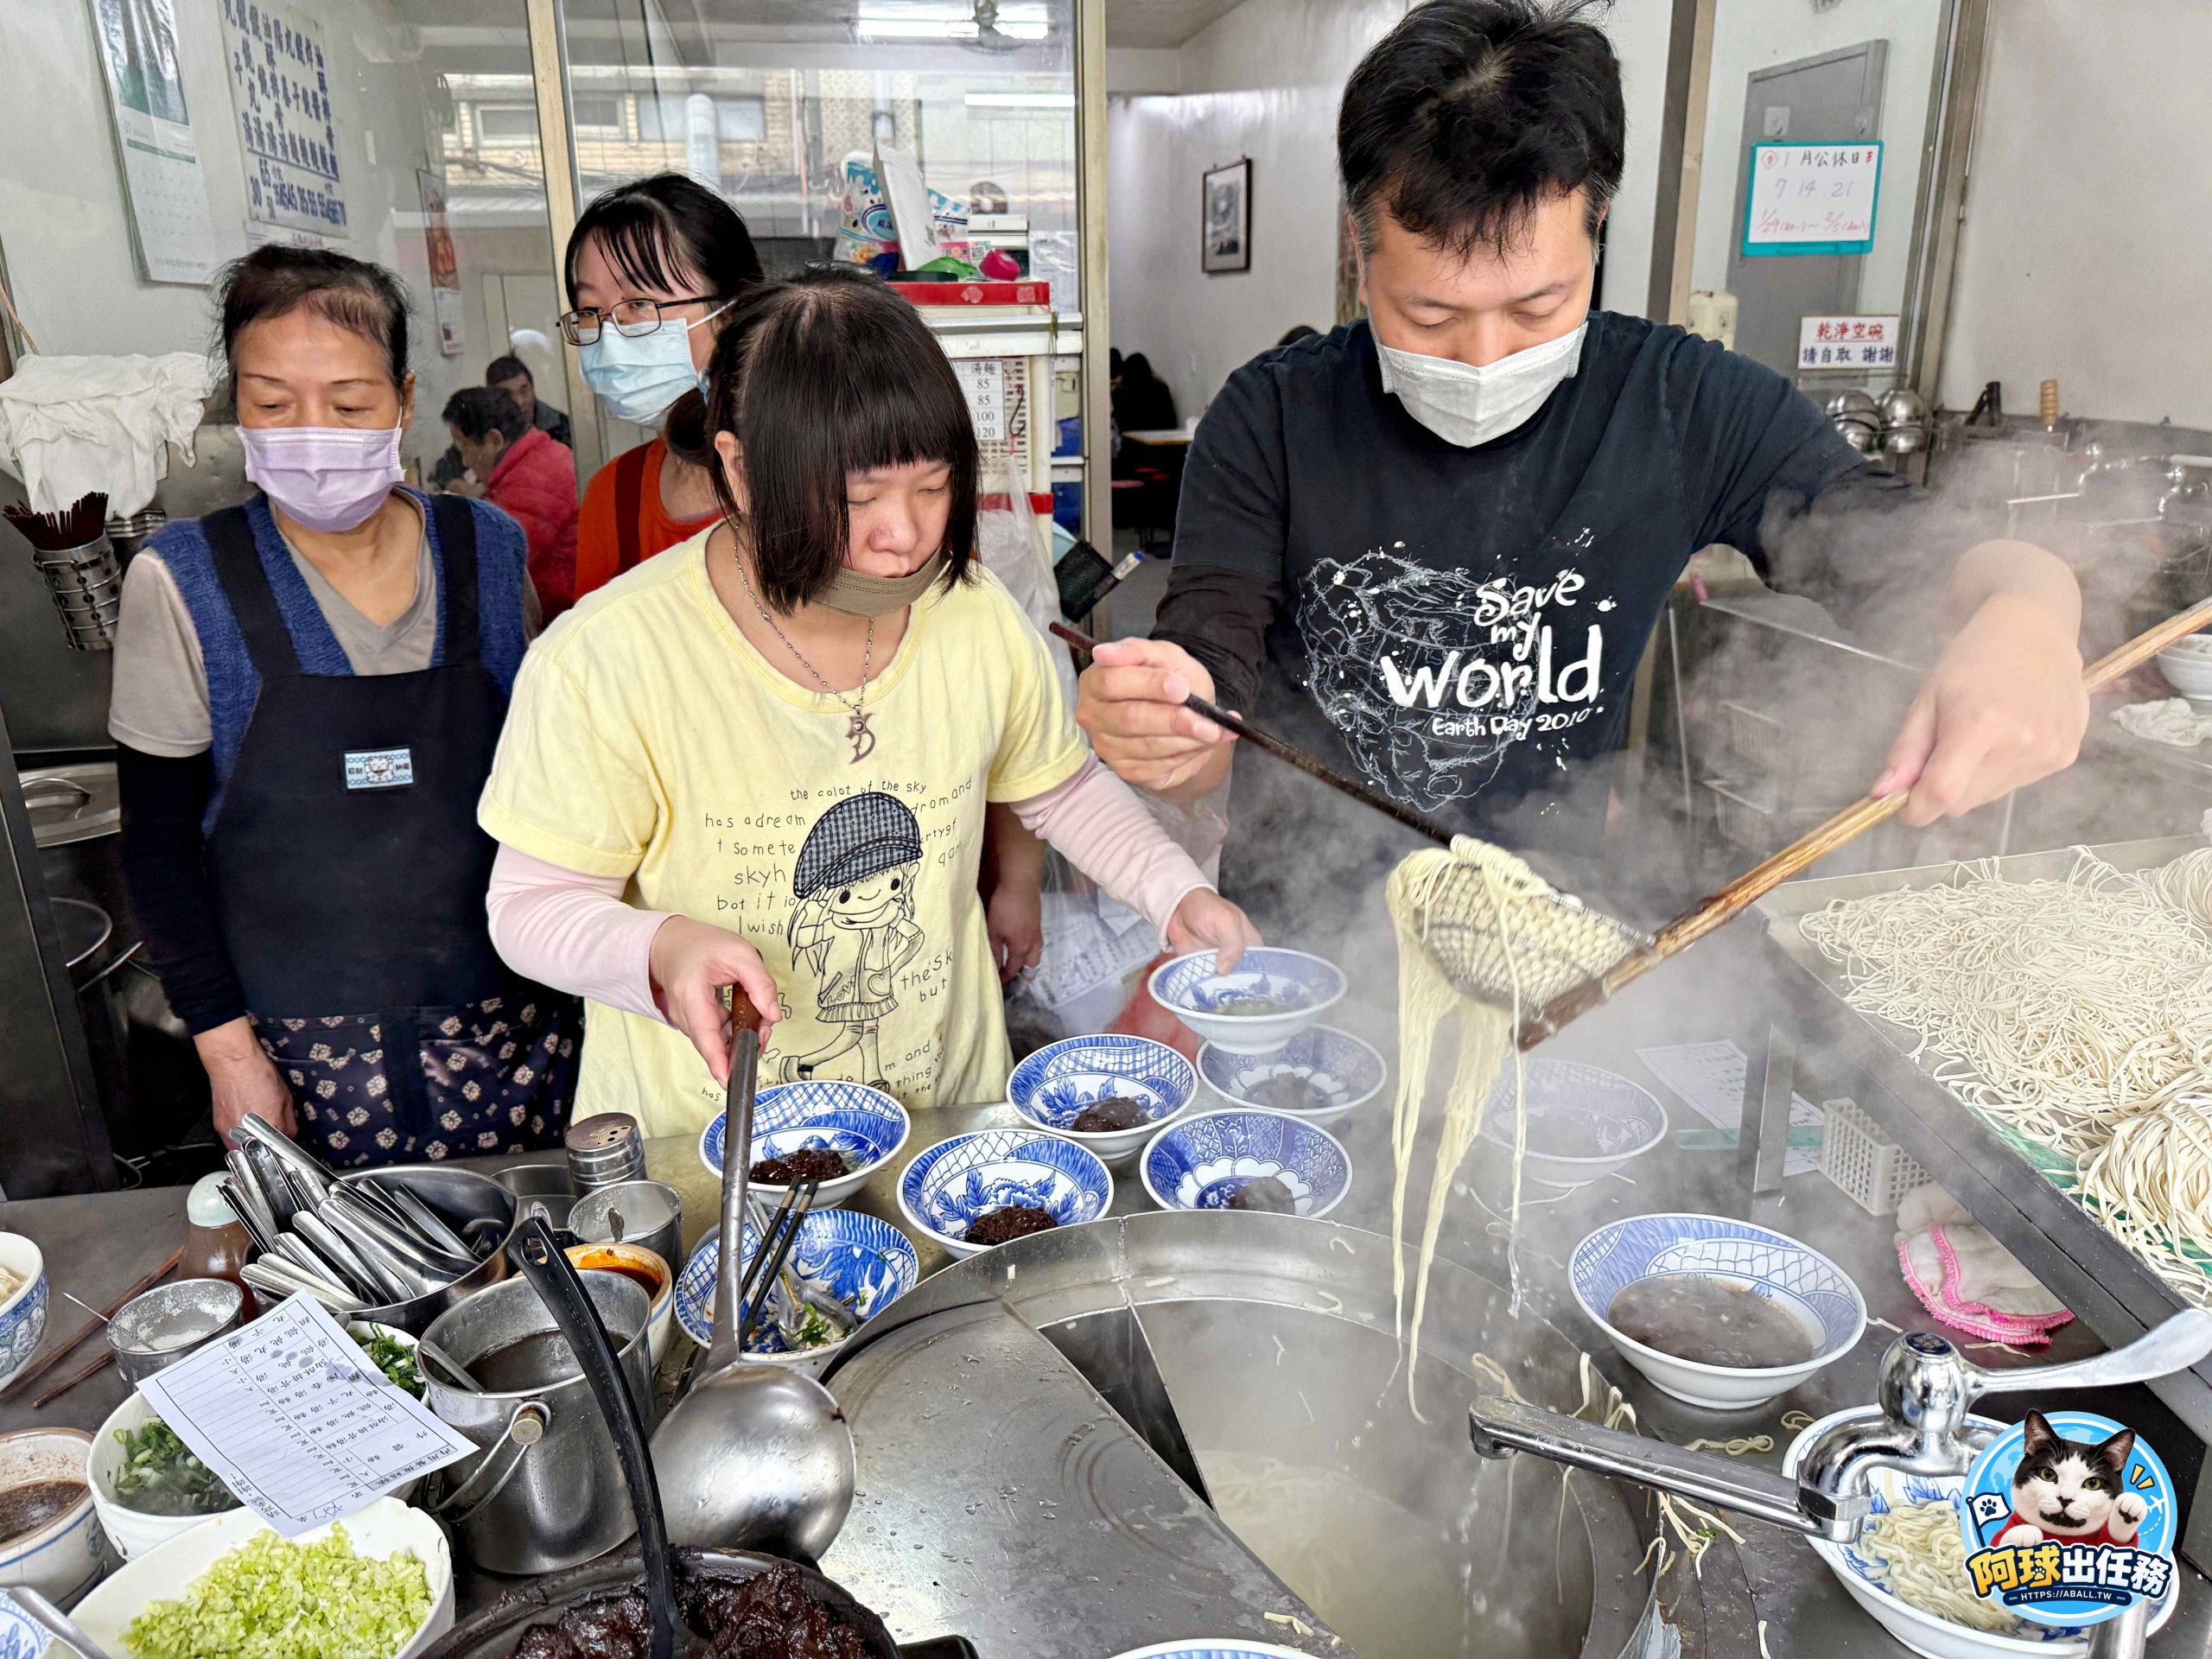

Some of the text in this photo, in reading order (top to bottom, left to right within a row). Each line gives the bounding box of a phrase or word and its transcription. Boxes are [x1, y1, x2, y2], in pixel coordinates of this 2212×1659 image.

[1816, 321, 1885, 340] 乾淨空碗
[1802, 346, 1894, 364] 請自取 謝謝
[976, 378, 989, 390] 85
[977, 395, 991, 406] 85
[976, 411, 995, 423] 100
[1473, 571, 1586, 626] Save
[1491, 612, 1541, 662] my
[1432, 708, 1592, 741] Earth Day 2010
[791, 789, 810, 801] the
[881, 781, 899, 792] the
[906, 781, 927, 793] sky
[705, 813, 734, 829] has
[734, 862, 786, 888] skyh
[717, 894, 745, 911] bot
[747, 918, 784, 936] wish
[919, 978, 947, 1002] but
[906, 1039, 931, 1062] and
[895, 1066, 932, 1088] thing
